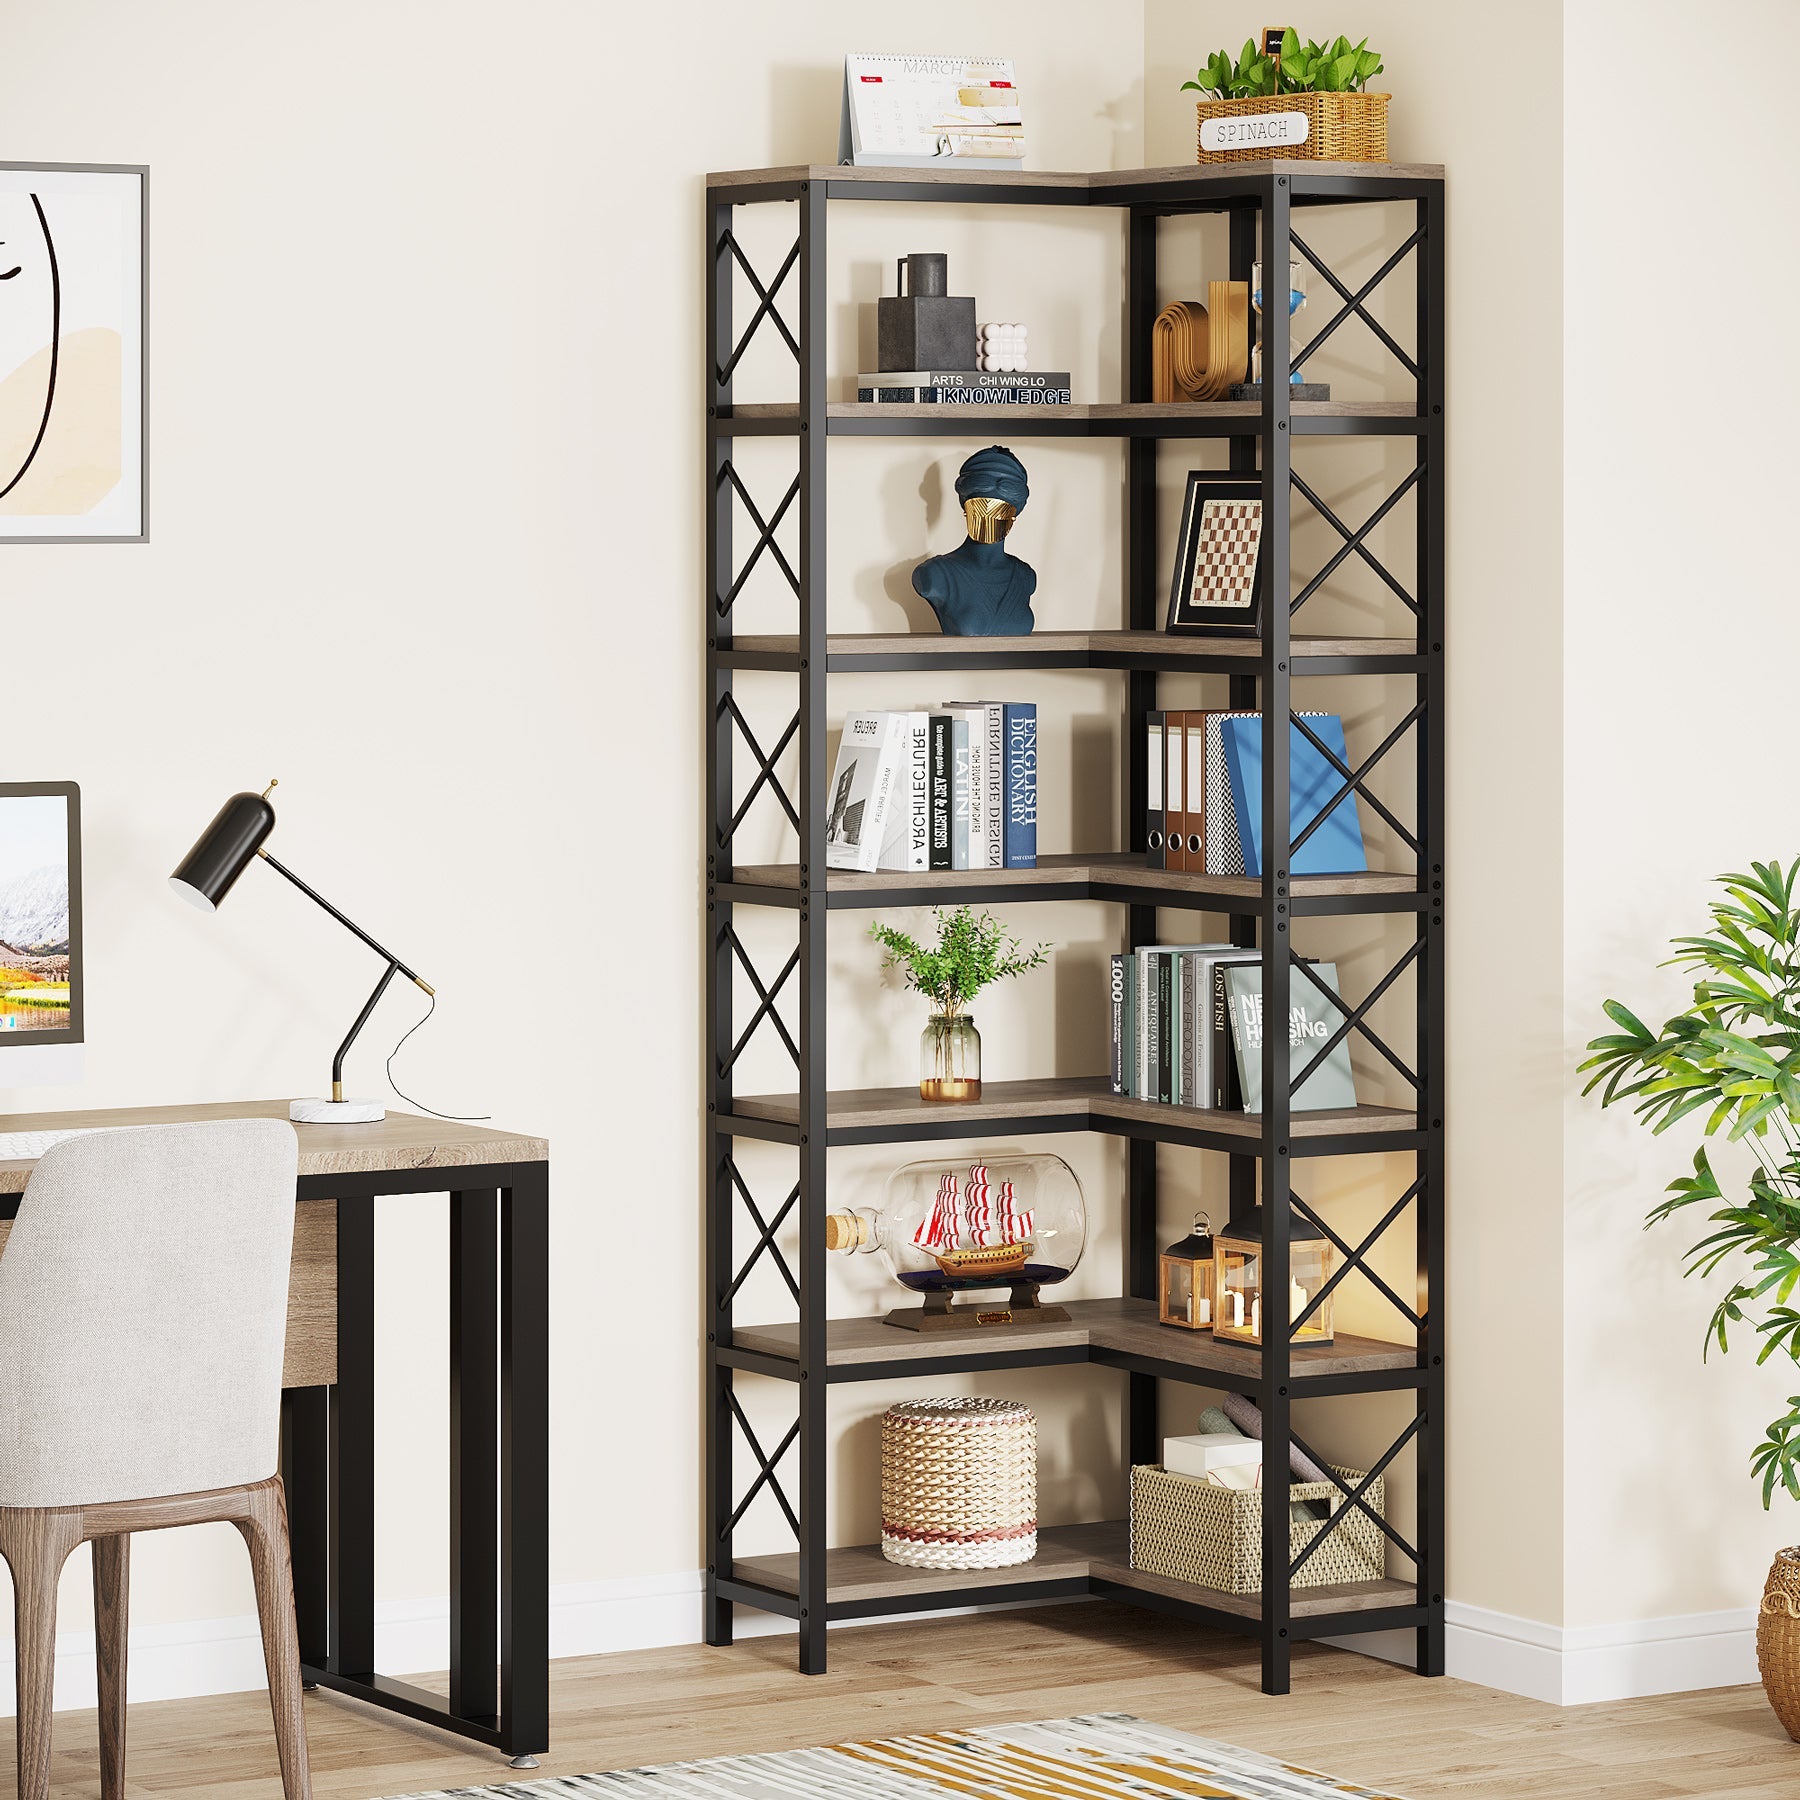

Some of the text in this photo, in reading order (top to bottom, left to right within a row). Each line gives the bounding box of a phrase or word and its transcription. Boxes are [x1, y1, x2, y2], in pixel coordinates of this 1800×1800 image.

[903, 62, 962, 75] MARCH
[1217, 120, 1288, 143] SPINACH
[932, 375, 1045, 387] ARTS CHI WING LO
[943, 387, 1071, 405] KNOWLEDGE
[1011, 717, 1025, 826] DICTIONARY
[1024, 717, 1037, 826] ENGLISH
[934, 777, 948, 797] ART
[934, 798, 948, 807] &
[934, 808, 948, 849] ARTISTS
[1111, 960, 1124, 1003] 1000
[1214, 966, 1224, 1031] LOST FISH
[1240, 993, 1263, 1010] NE
[1149, 990, 1157, 1065] ANTIQUAIRES
[1183, 956, 1193, 1098] ALEXEY BRODOVITCH
[1197, 1033, 1204, 1042] in
[1245, 1020, 1329, 1041] HSING
